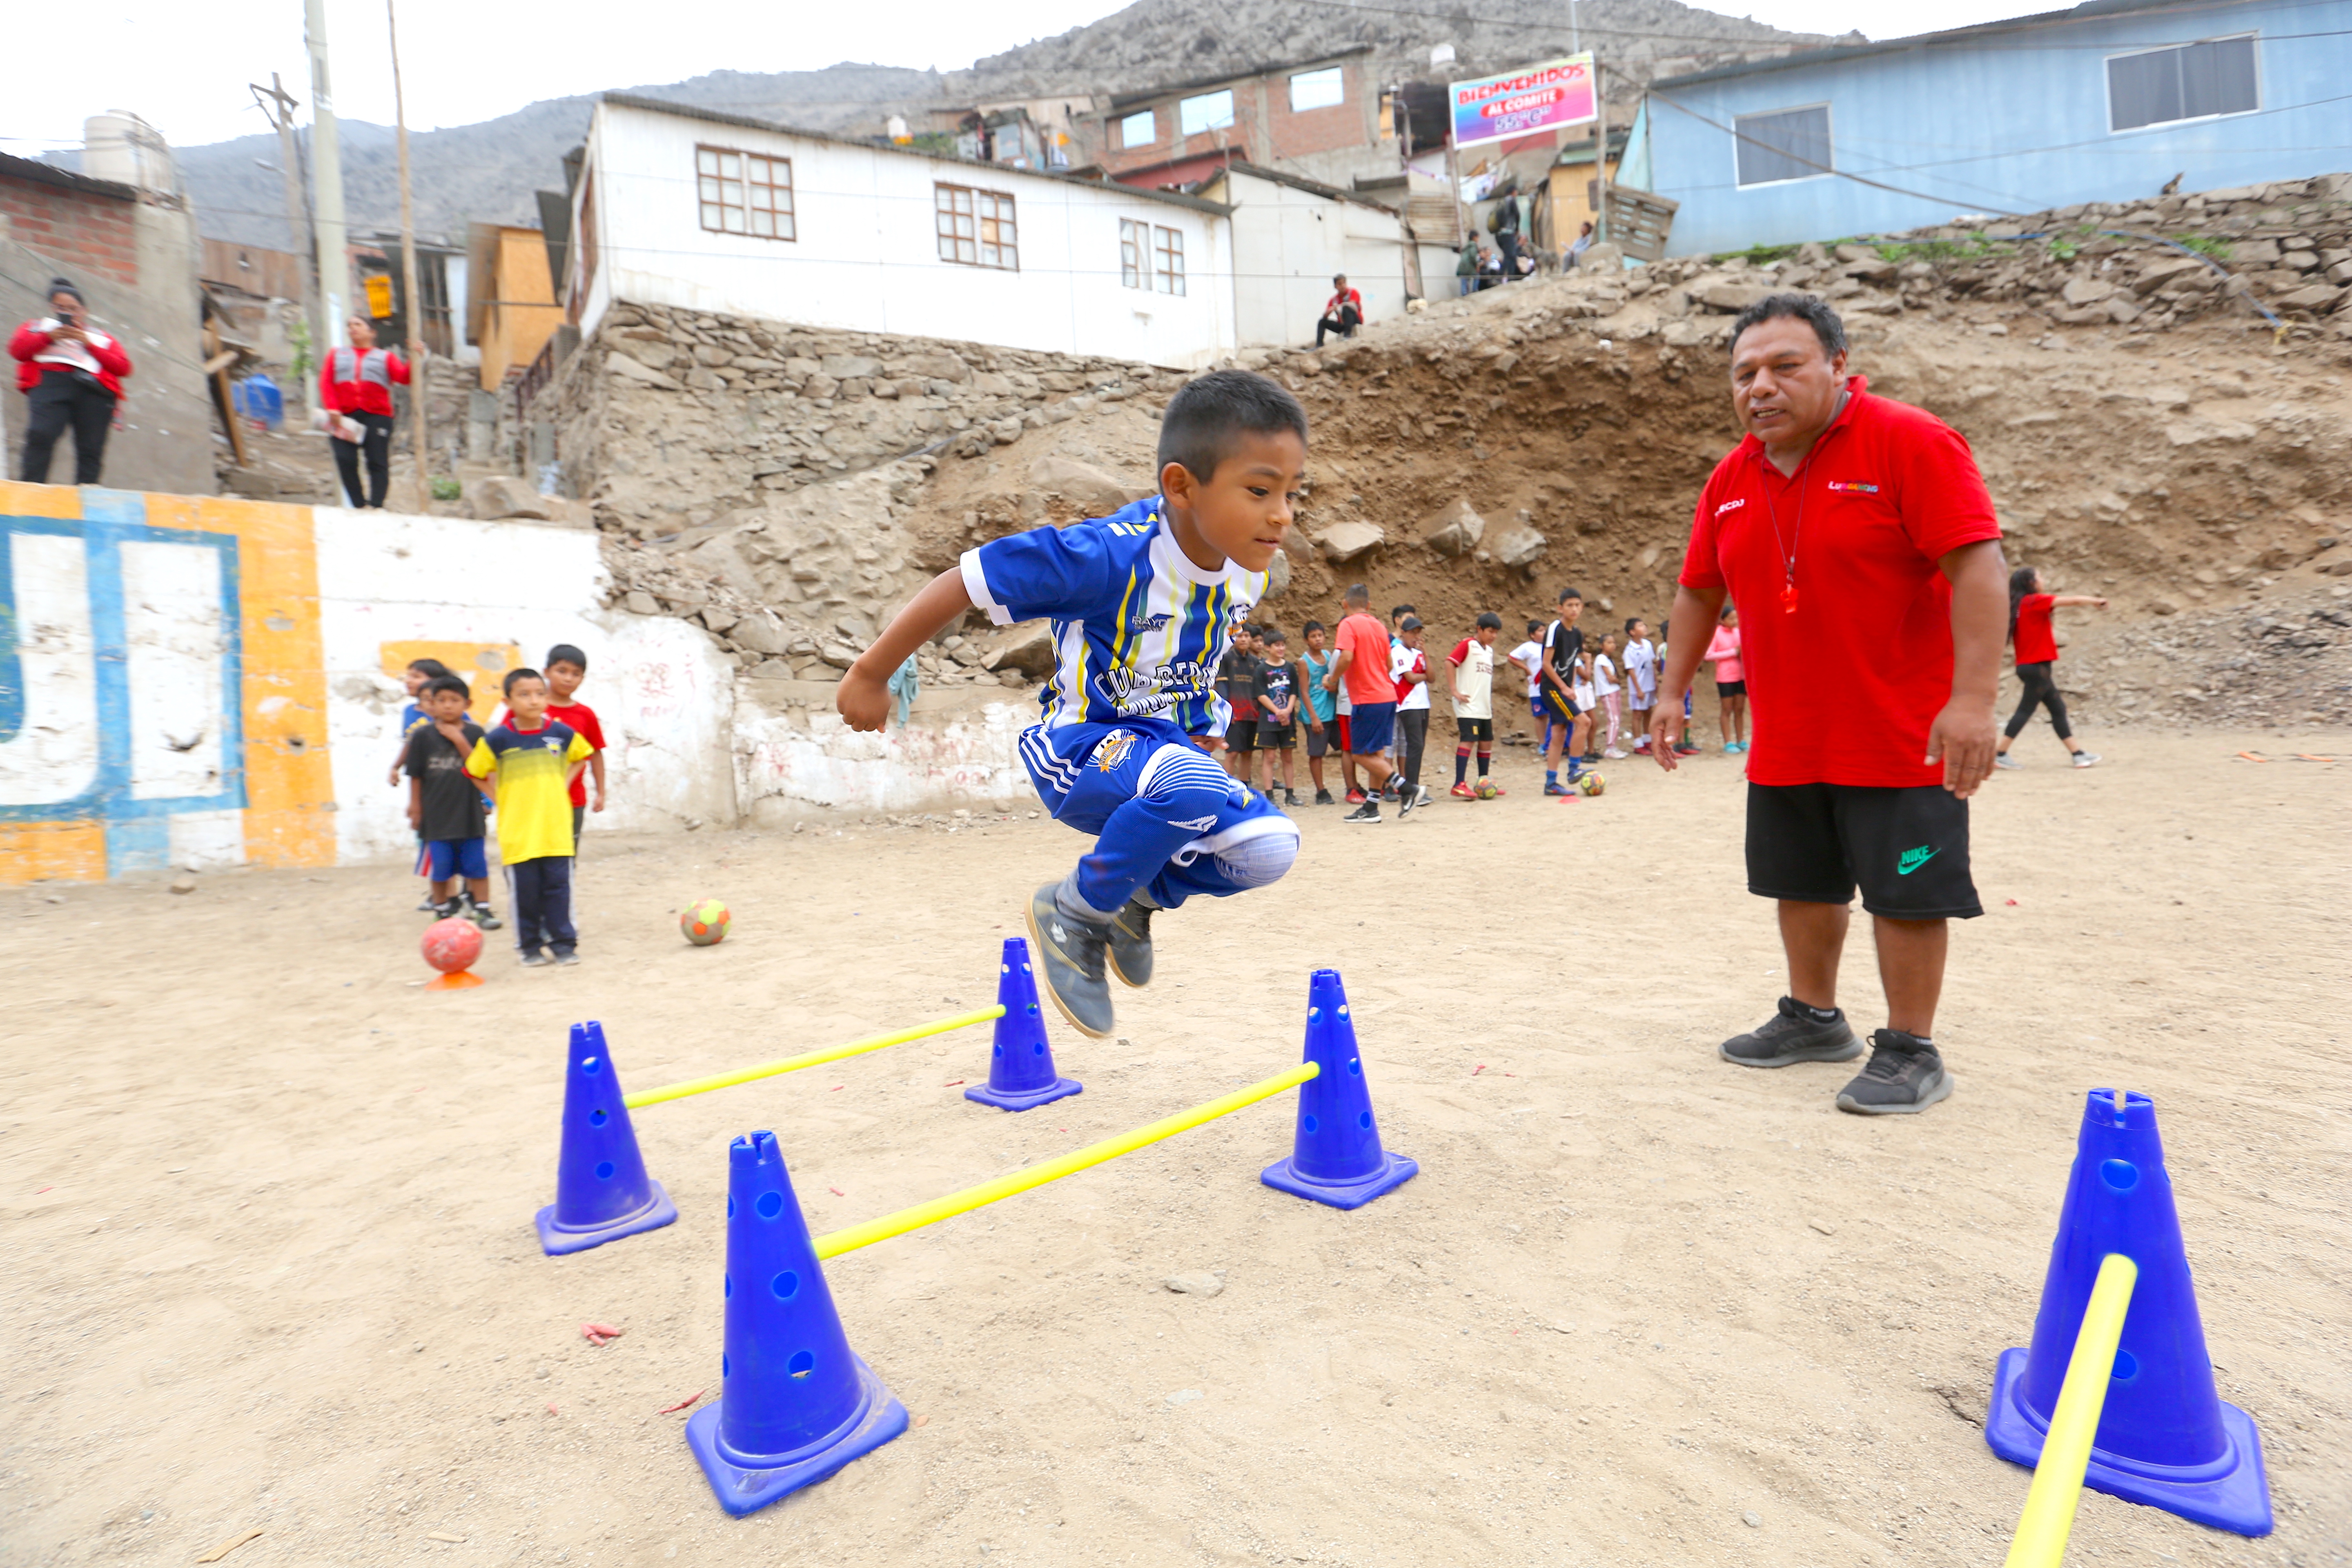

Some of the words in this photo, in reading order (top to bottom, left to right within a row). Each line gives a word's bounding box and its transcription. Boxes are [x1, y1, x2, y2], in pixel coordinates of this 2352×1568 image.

[1459, 63, 1584, 105] BIENVENIDOS
[1488, 103, 1503, 116] AL
[1901, 845, 1930, 865] NIKE
